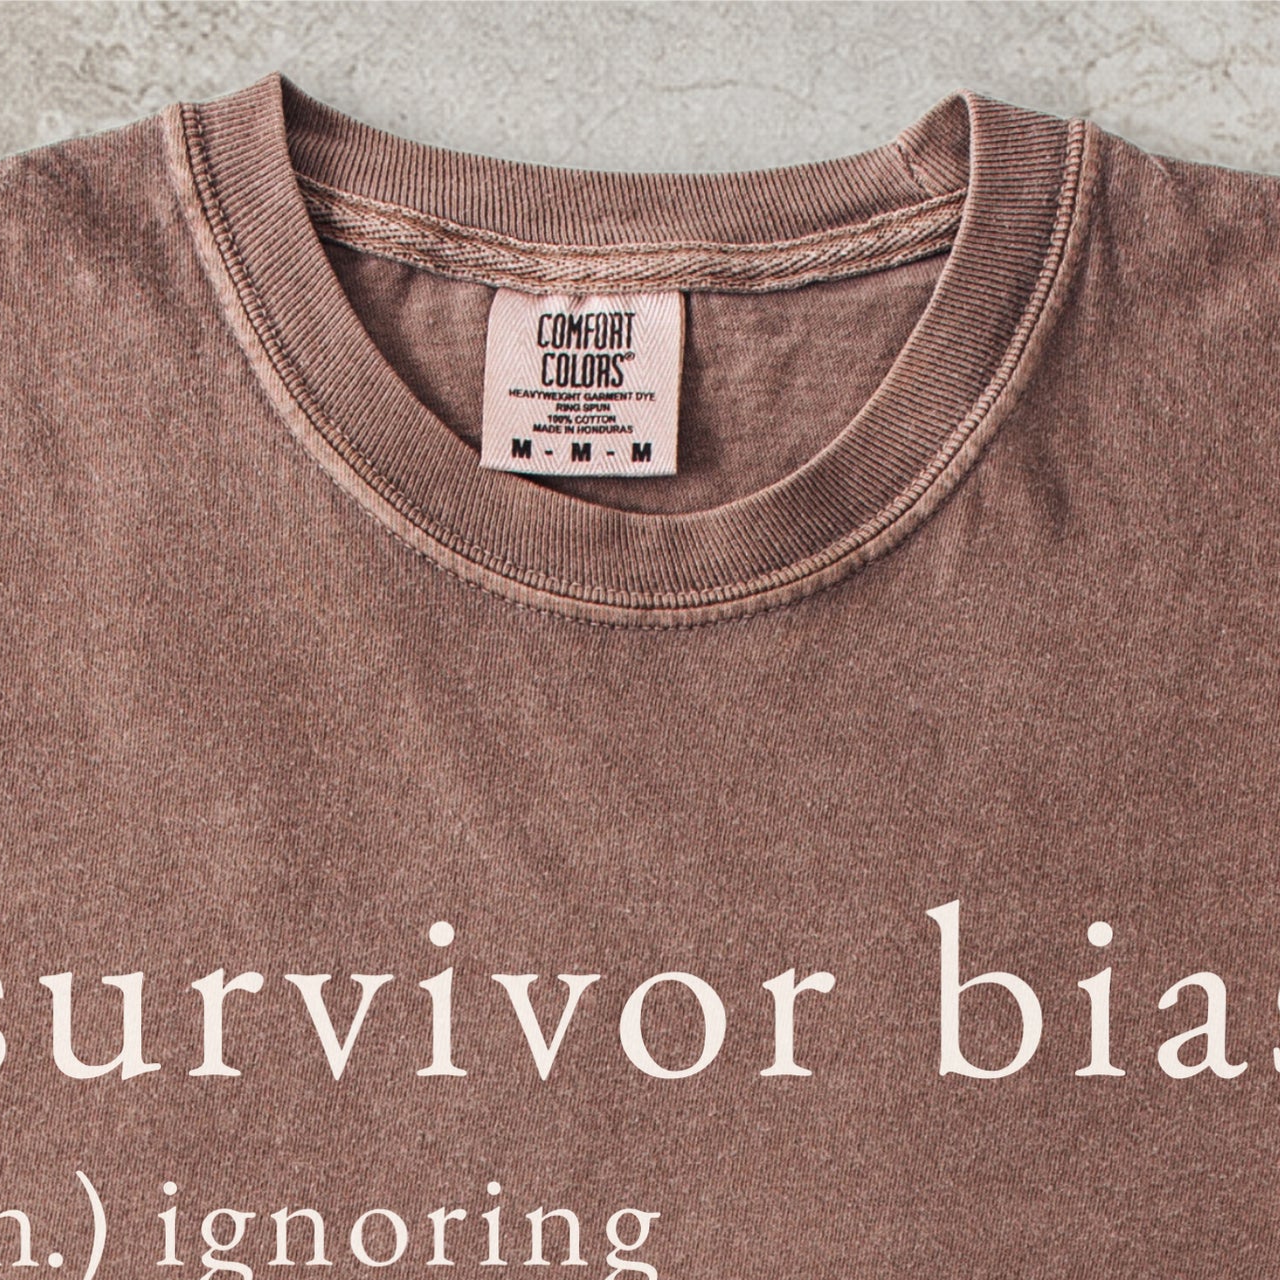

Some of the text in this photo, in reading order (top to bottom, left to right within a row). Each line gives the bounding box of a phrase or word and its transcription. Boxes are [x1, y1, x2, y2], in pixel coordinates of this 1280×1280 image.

[537, 312, 636, 350] COMFORT
[508, 388, 656, 402] HEAVYWEIGHT GARMENT DYE
[555, 403, 611, 412] RING SPUN
[547, 414, 616, 424] 100% COTTON
[532, 423, 634, 434] MADE IN HONDURAS
[511, 438, 532, 459] M
[571, 442, 591, 463] M
[631, 442, 652, 463] M
